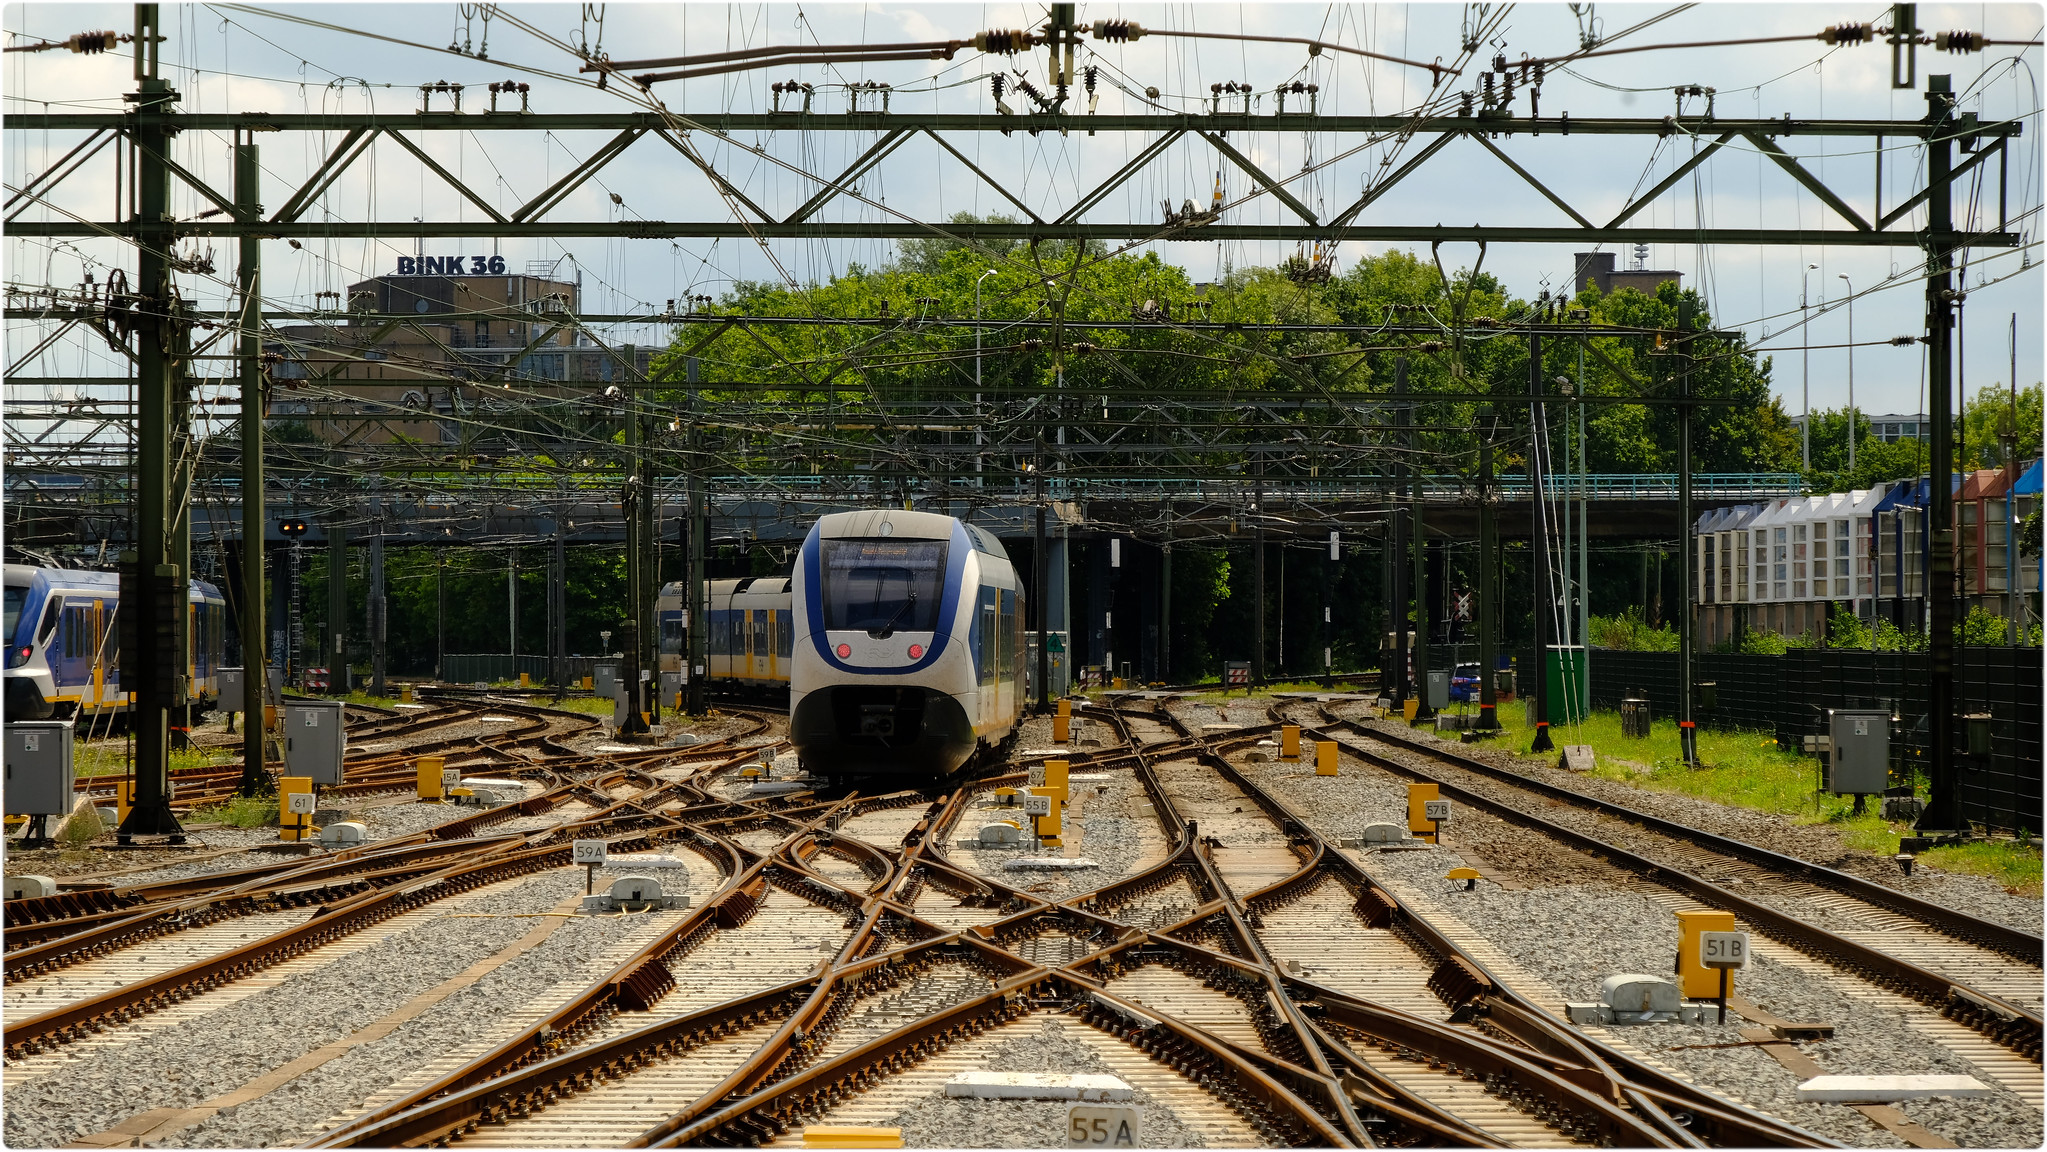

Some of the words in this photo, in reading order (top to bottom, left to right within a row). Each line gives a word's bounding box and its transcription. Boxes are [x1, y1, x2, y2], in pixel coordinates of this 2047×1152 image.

[470, 255, 506, 275] 36
[1050, 638, 1058, 650] 4
[760, 750, 775, 759] 59B
[294, 798, 306, 808] 61
[1025, 800, 1048, 811] 55B
[1427, 805, 1449, 815] 57B
[576, 846, 603, 858] 59A
[1706, 939, 1742, 957] 51B
[1070, 1117, 1134, 1146] 55A
